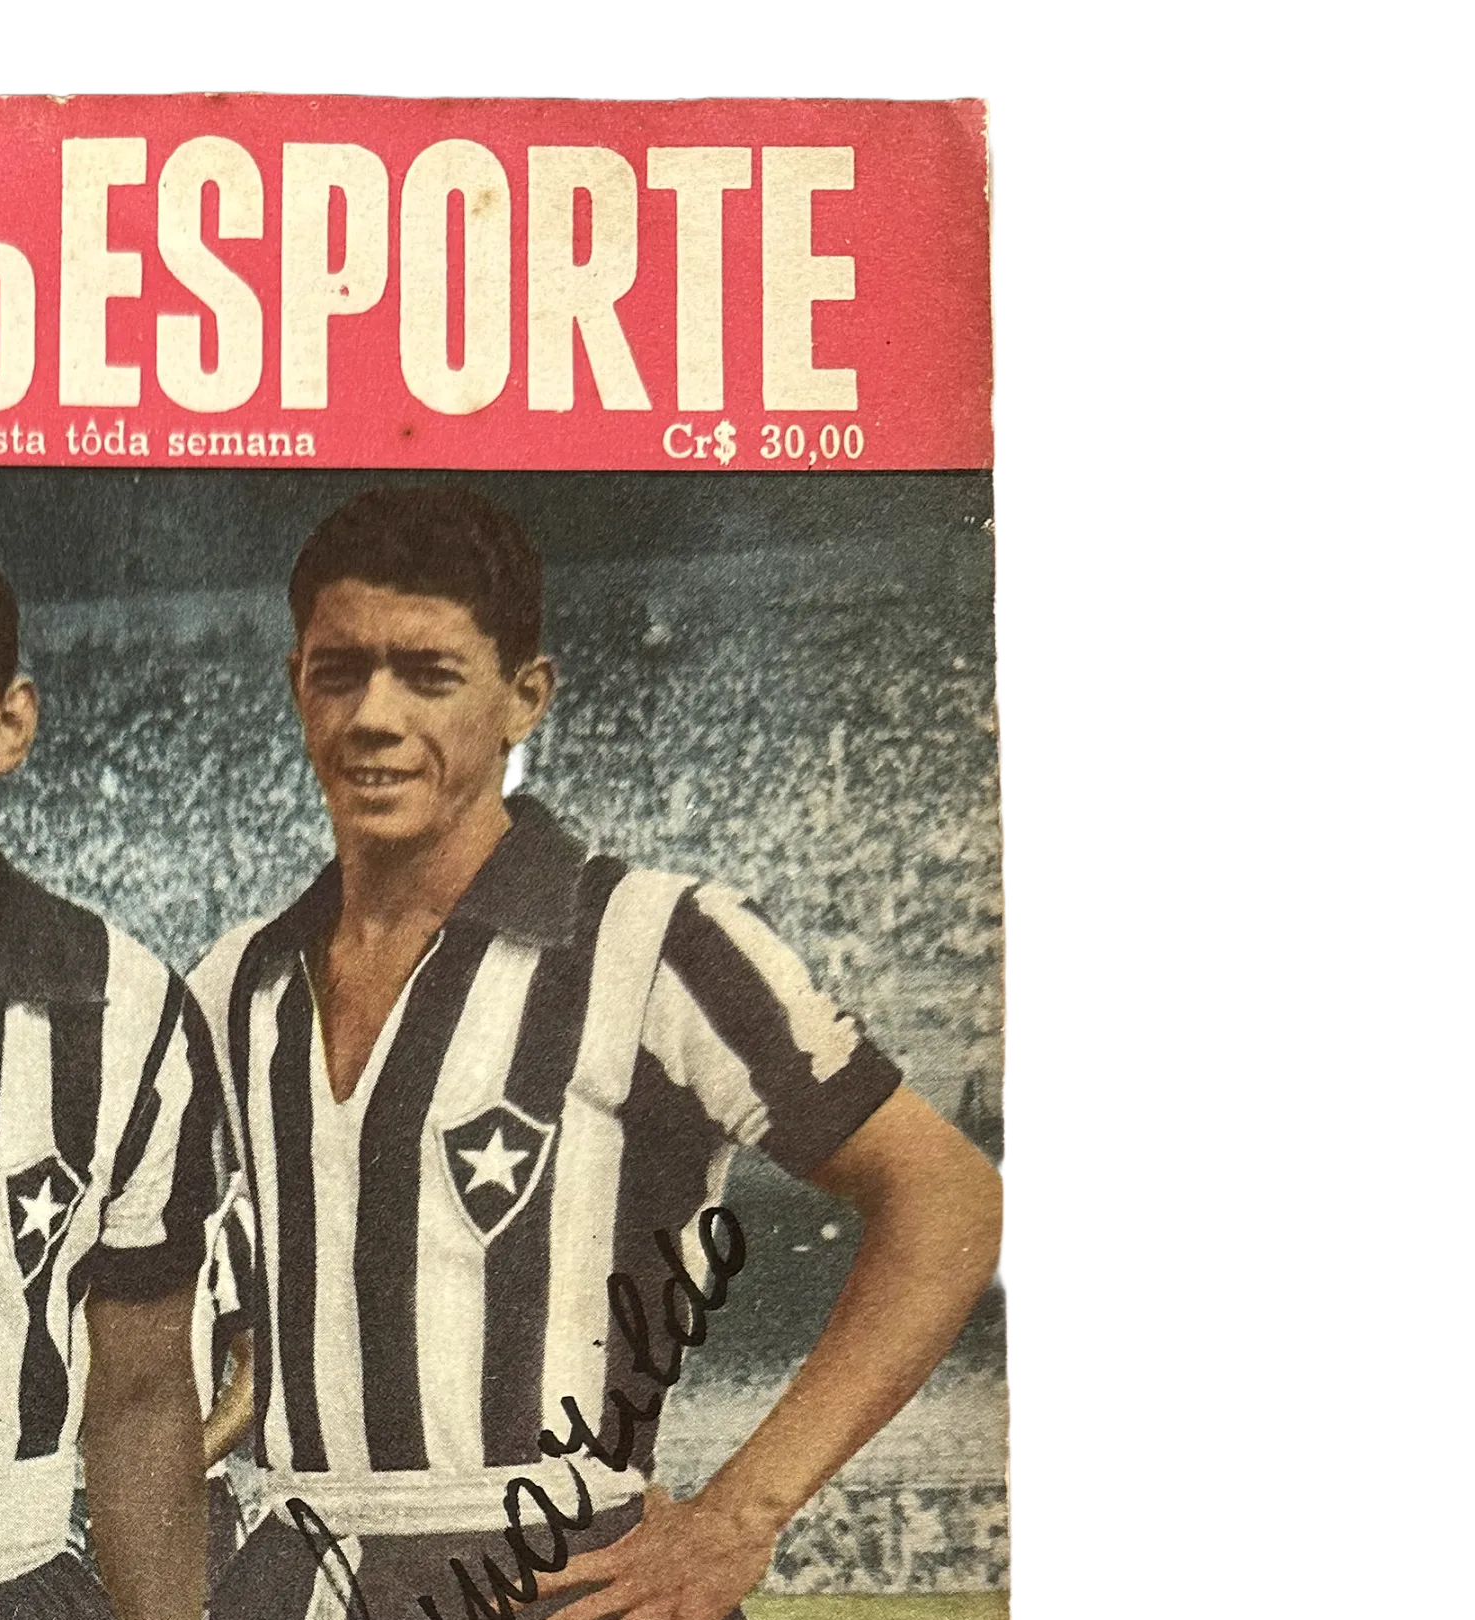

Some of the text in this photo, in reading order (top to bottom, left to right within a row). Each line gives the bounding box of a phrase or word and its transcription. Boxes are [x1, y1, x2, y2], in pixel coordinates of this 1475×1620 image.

[59, 135, 858, 414] ESPORTE
[66, 419, 149, 456] tôda
[169, 432, 315, 456] semana
[663, 420, 864, 465] Cr$ 30,00
